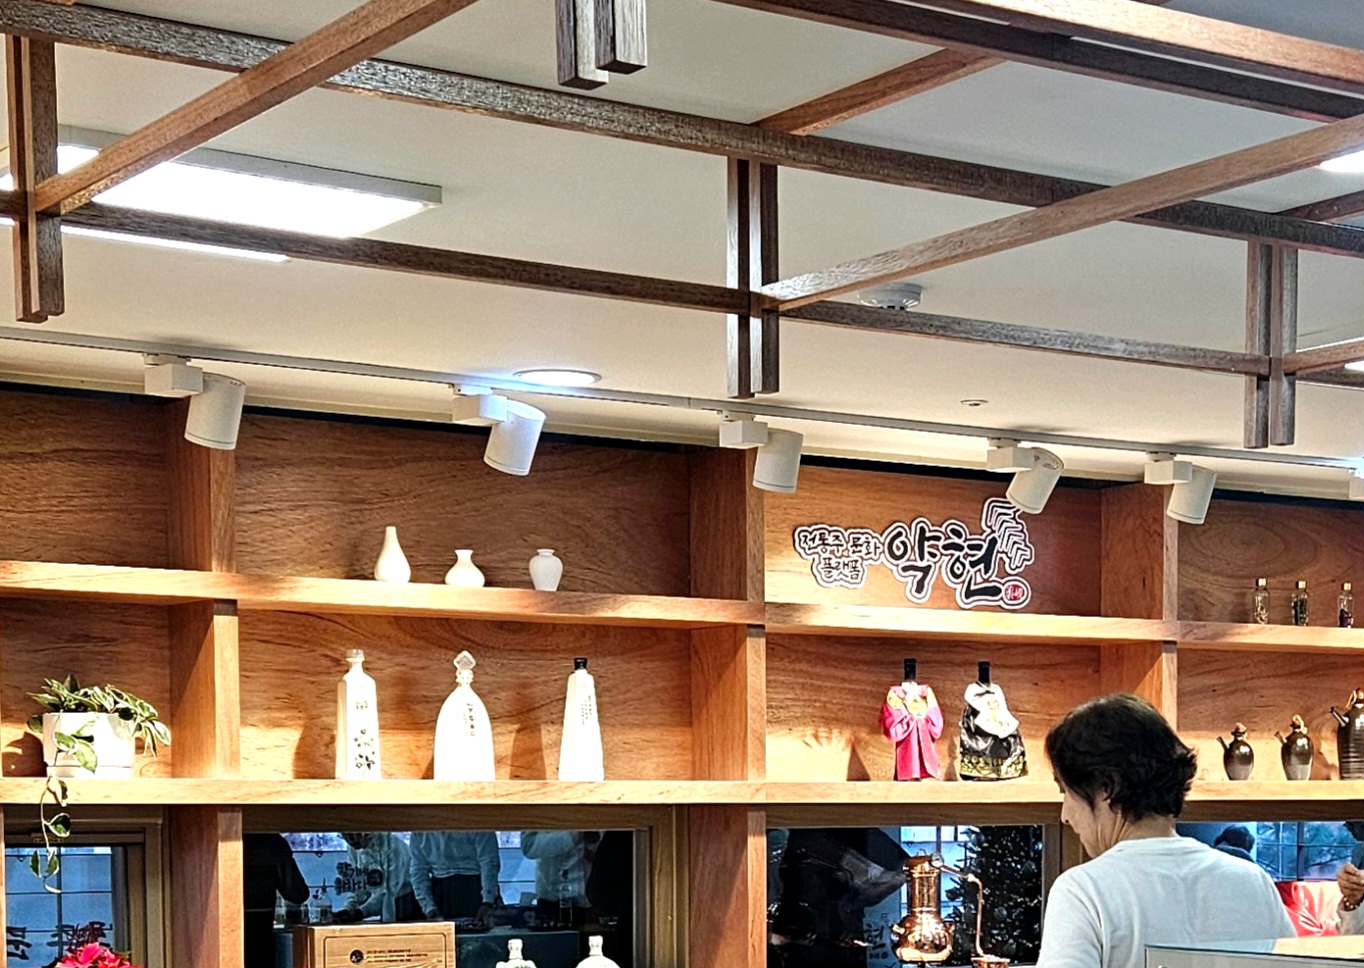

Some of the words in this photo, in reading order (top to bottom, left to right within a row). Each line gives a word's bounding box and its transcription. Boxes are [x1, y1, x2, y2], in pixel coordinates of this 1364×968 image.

[801, 531, 845, 555] 전통주
[849, 533, 881, 558] 문화
[820, 556, 862, 581] 플랫폼
[885, 524, 1003, 600] 약현
